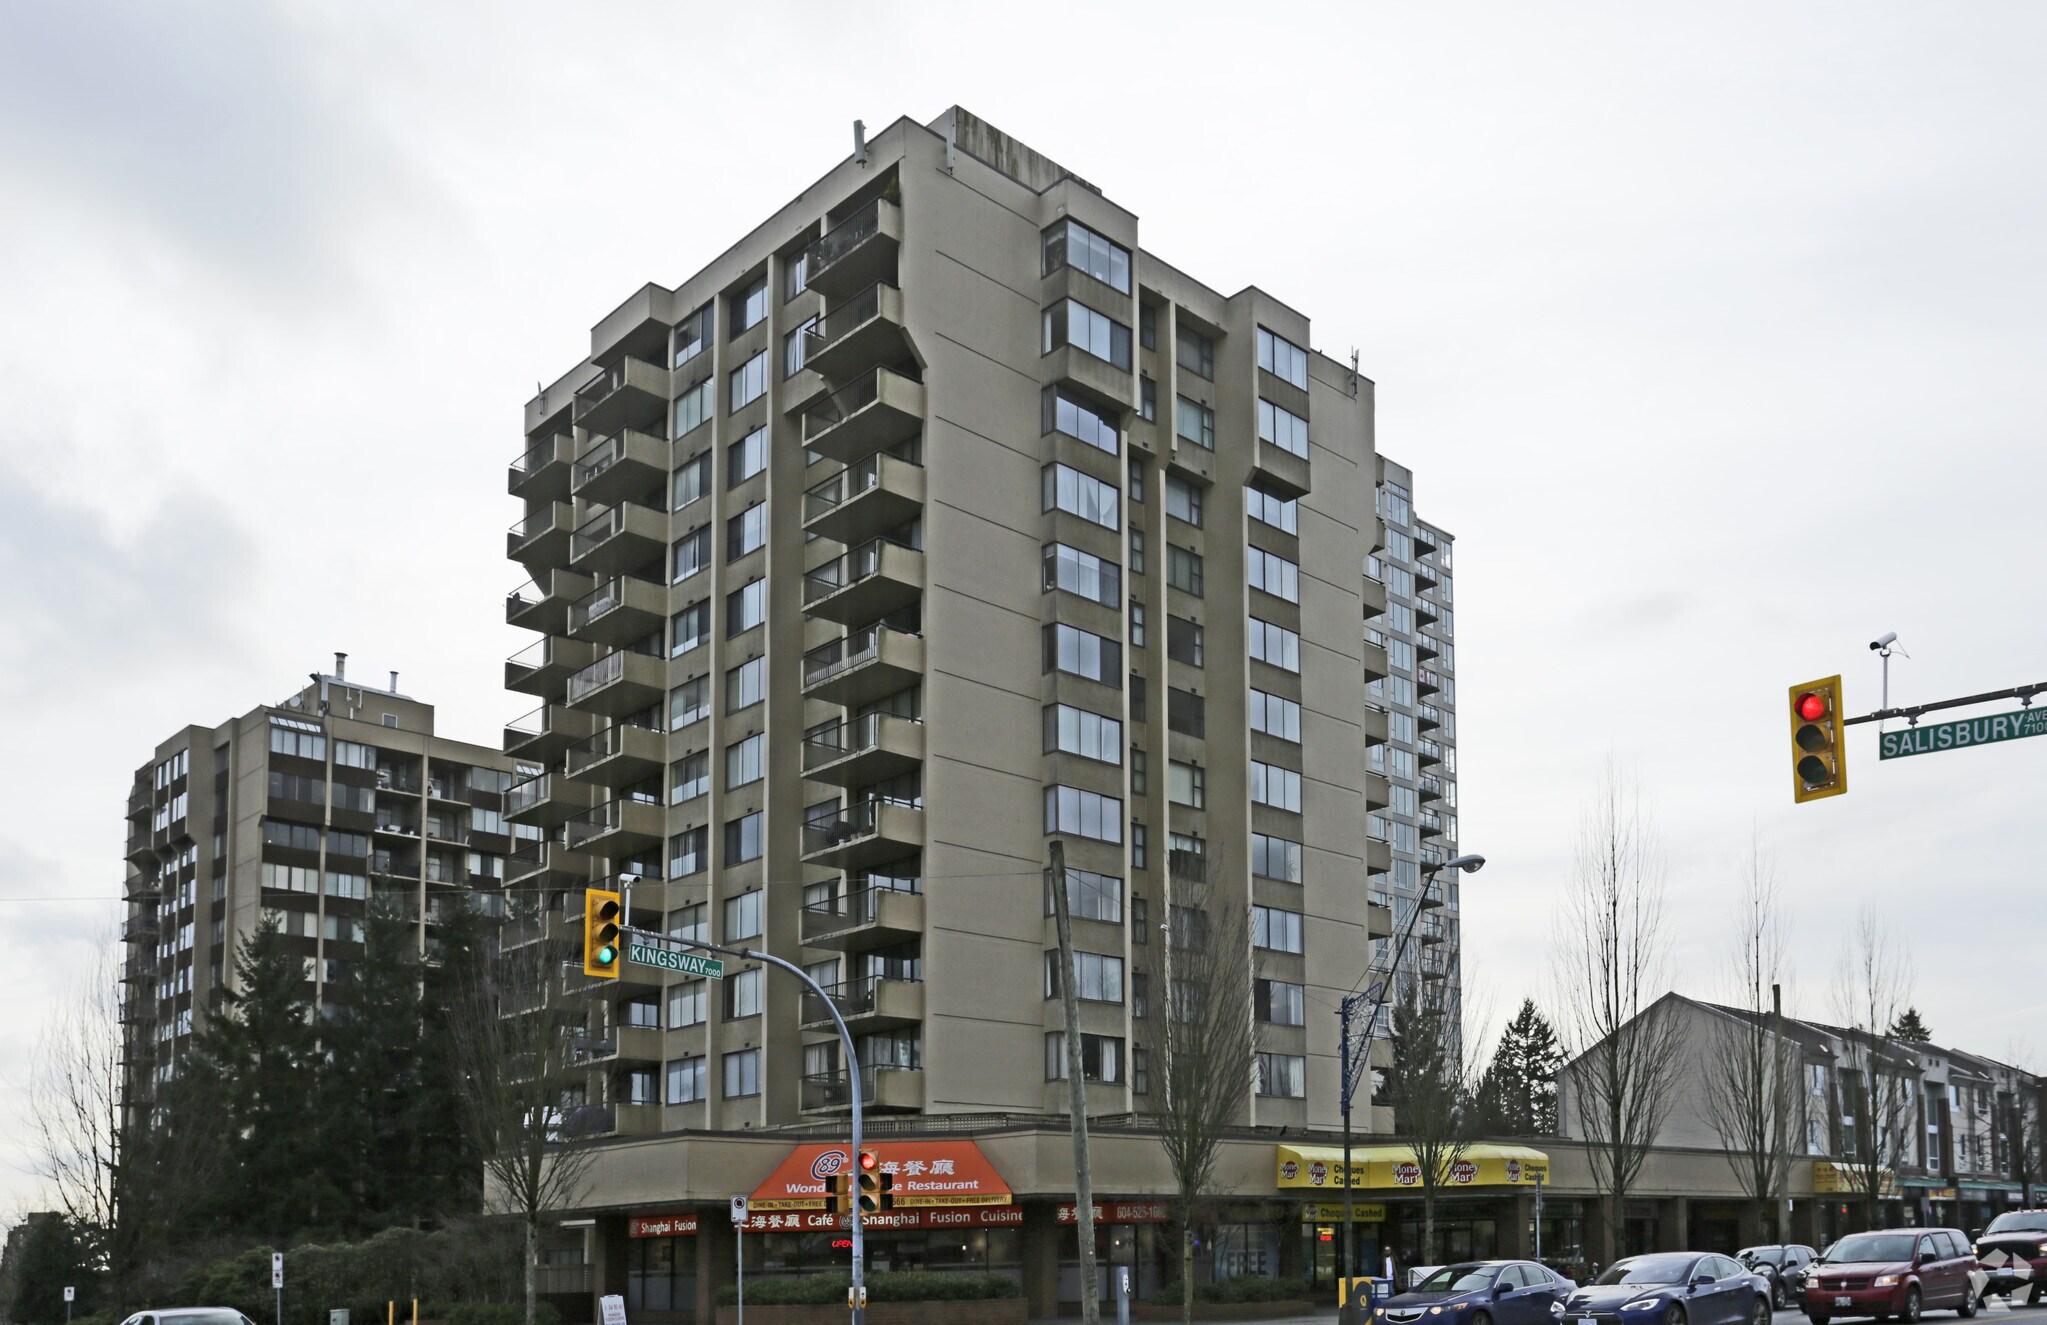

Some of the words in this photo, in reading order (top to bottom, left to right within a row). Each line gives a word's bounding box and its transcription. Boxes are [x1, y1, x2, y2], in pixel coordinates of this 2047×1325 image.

[1883, 713, 2025, 757] SALISBURY
[2027, 710, 2047, 723] AVE
[631, 946, 706, 974] KINGSWAY
[705, 967, 721, 977] 7000
[1280, 1162, 1299, 1173] Money
[1308, 1163, 1328, 1174] Money
[1334, 1164, 1364, 1175] Chues
[1505, 1160, 1521, 1171] Money
[1525, 1164, 1547, 1172] Cheques
[1282, 1171, 1297, 1179] Mart
[1310, 1174, 1326, 1184] Mart
[1394, 1174, 1420, 1184] Mart
[1450, 1173, 1475, 1182] Mart
[1507, 1171, 1520, 1180] Mart
[908, 1180, 979, 1191] Restaurant
[1334, 1176, 1360, 1185] Caed
[1355, 1208, 1383, 1218] Cashed
[807, 1213, 834, 1226] Café
[862, 1212, 920, 1227] Shanghai
[930, 1211, 971, 1223] Fusion
[980, 1210, 1023, 1222] Cuisine
[641, 1221, 671, 1235] Shanghai
[674, 1219, 697, 1231] Fusion
